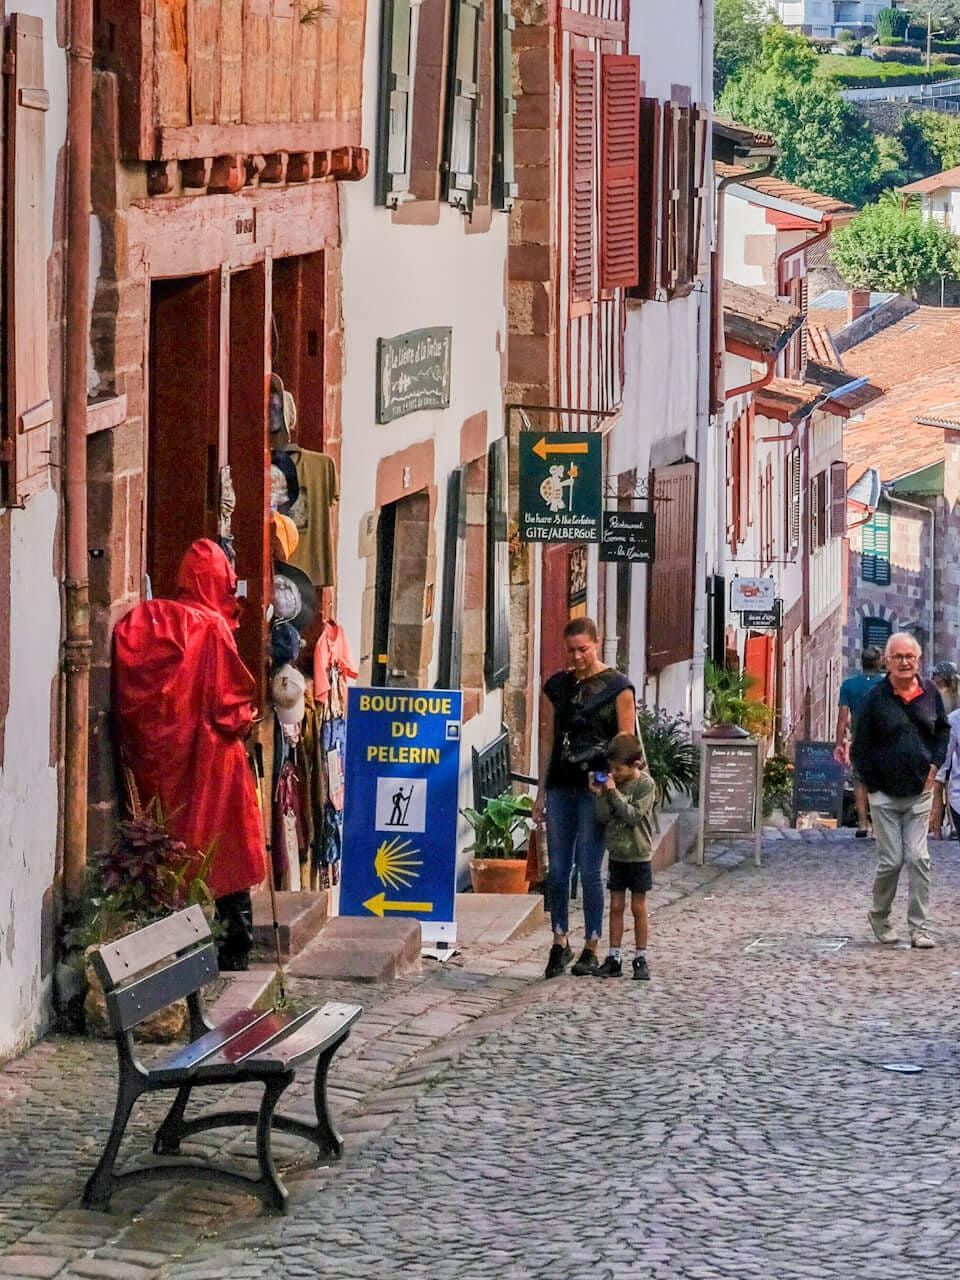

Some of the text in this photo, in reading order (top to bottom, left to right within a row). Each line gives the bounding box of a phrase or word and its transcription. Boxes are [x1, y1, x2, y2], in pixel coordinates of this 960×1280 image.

[360, 695, 451, 716] BOUTIQUE
[391, 721, 418, 738] DU
[367, 746, 440, 764] PELERIN
